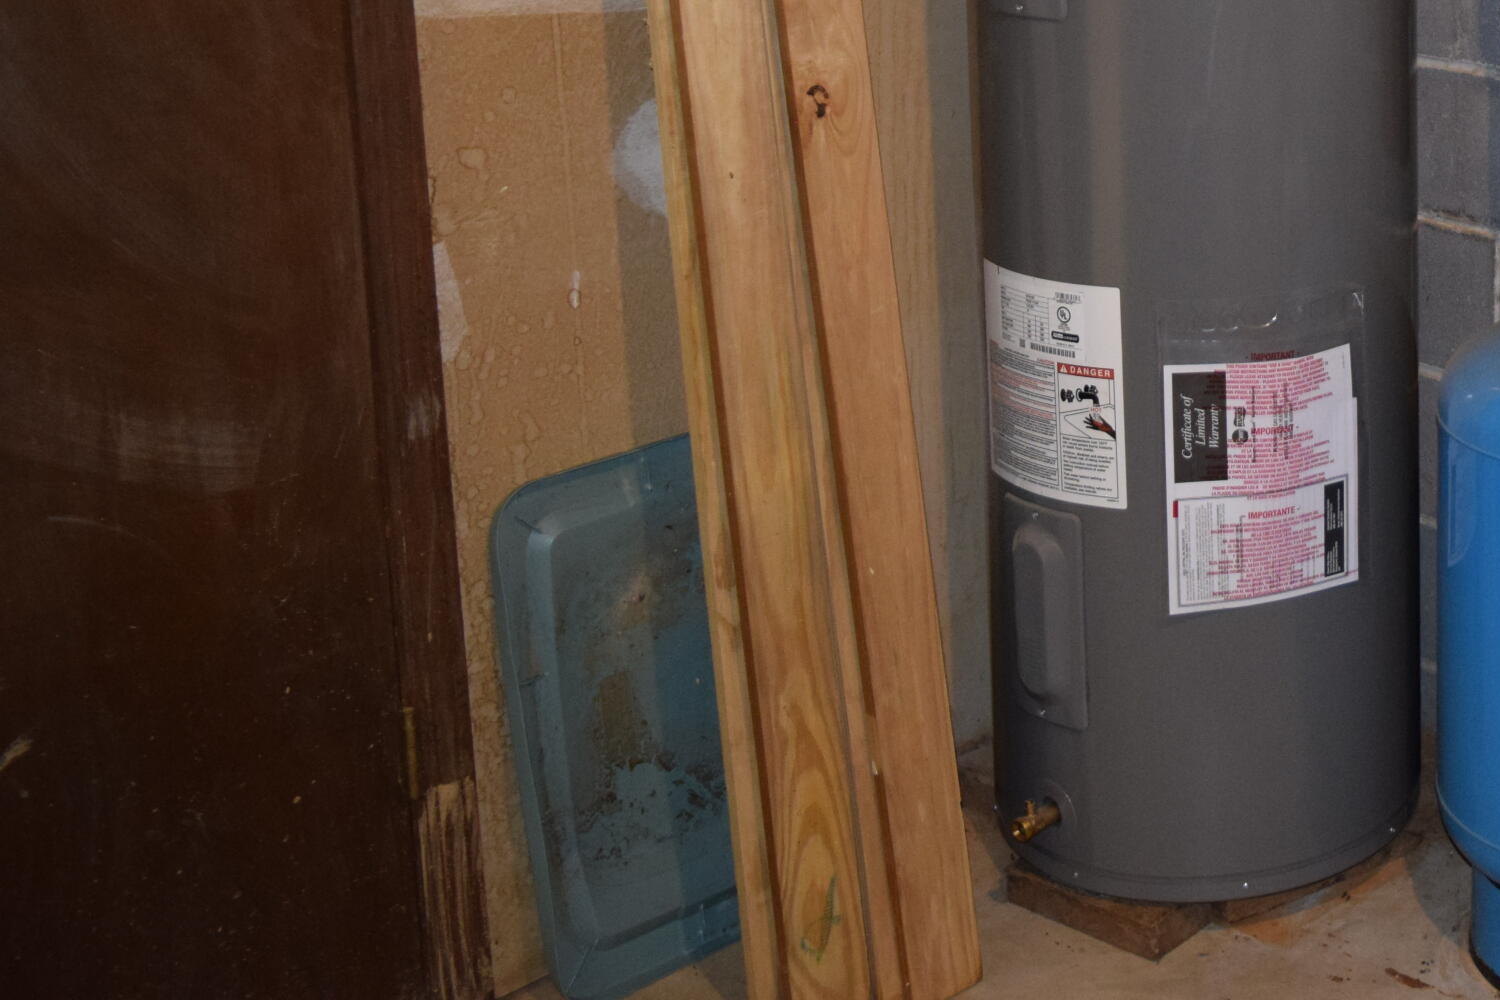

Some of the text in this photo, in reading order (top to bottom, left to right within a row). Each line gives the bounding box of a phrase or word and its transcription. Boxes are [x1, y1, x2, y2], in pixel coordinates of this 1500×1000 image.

[1251, 351, 1295, 361] IMPORTANT
[1070, 366, 1111, 378] DANGER
[1180, 392, 1194, 459] Certificate of
[1194, 407, 1206, 446] Limited
[1208, 403, 1220, 448] Warranty
[1251, 424, 1295, 436] IMPORTANT
[1248, 506, 1296, 519] IMPORTANTE
